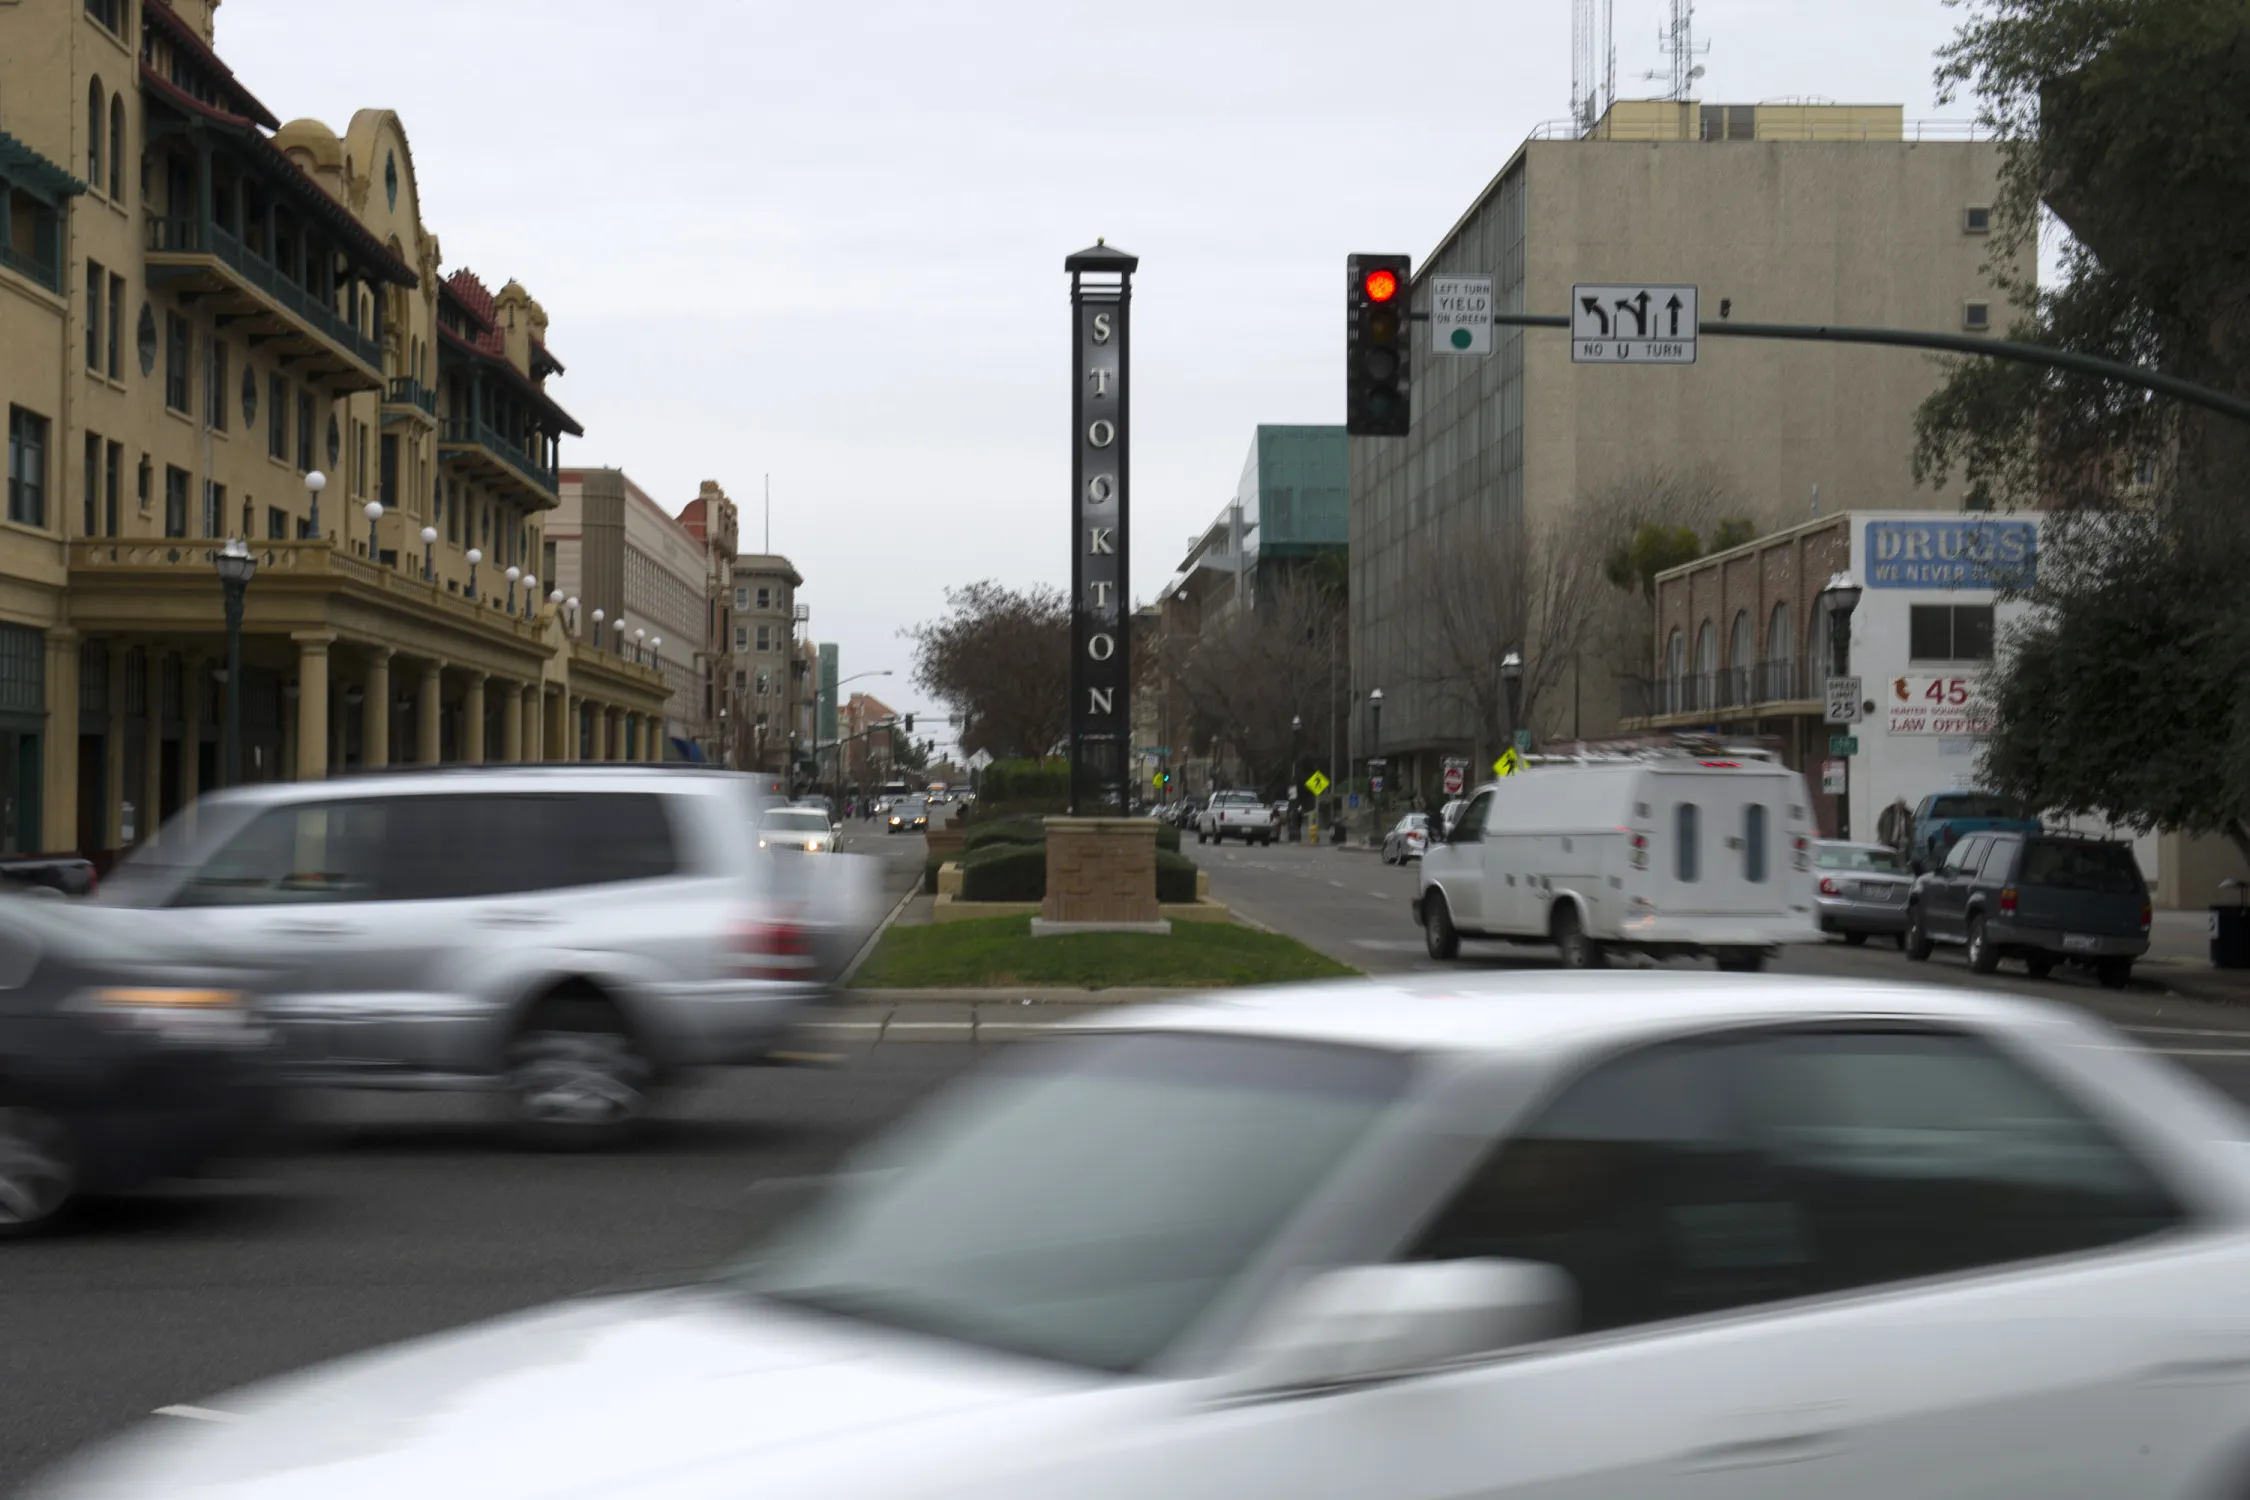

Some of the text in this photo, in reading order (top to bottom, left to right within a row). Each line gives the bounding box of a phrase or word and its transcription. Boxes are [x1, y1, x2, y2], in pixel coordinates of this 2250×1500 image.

[1434, 283, 1490, 295] LEFT TURN
[1440, 297, 1486, 311] YIELD
[1436, 313, 1488, 325] ON GREEN
[1583, 343, 1683, 360] NO U TURN
[1088, 312, 1115, 715] STOCKTON
[1874, 527, 2028, 562] DRUGS
[1876, 564, 1898, 582] WE
[1906, 564, 1965, 582] NEVER
[1828, 681, 1858, 691] SPEED
[1925, 678, 1969, 705] 45
[1831, 691, 1855, 699] LIMIT
[1831, 701, 1856, 719] 25
[1891, 718, 1926, 733] LAW
